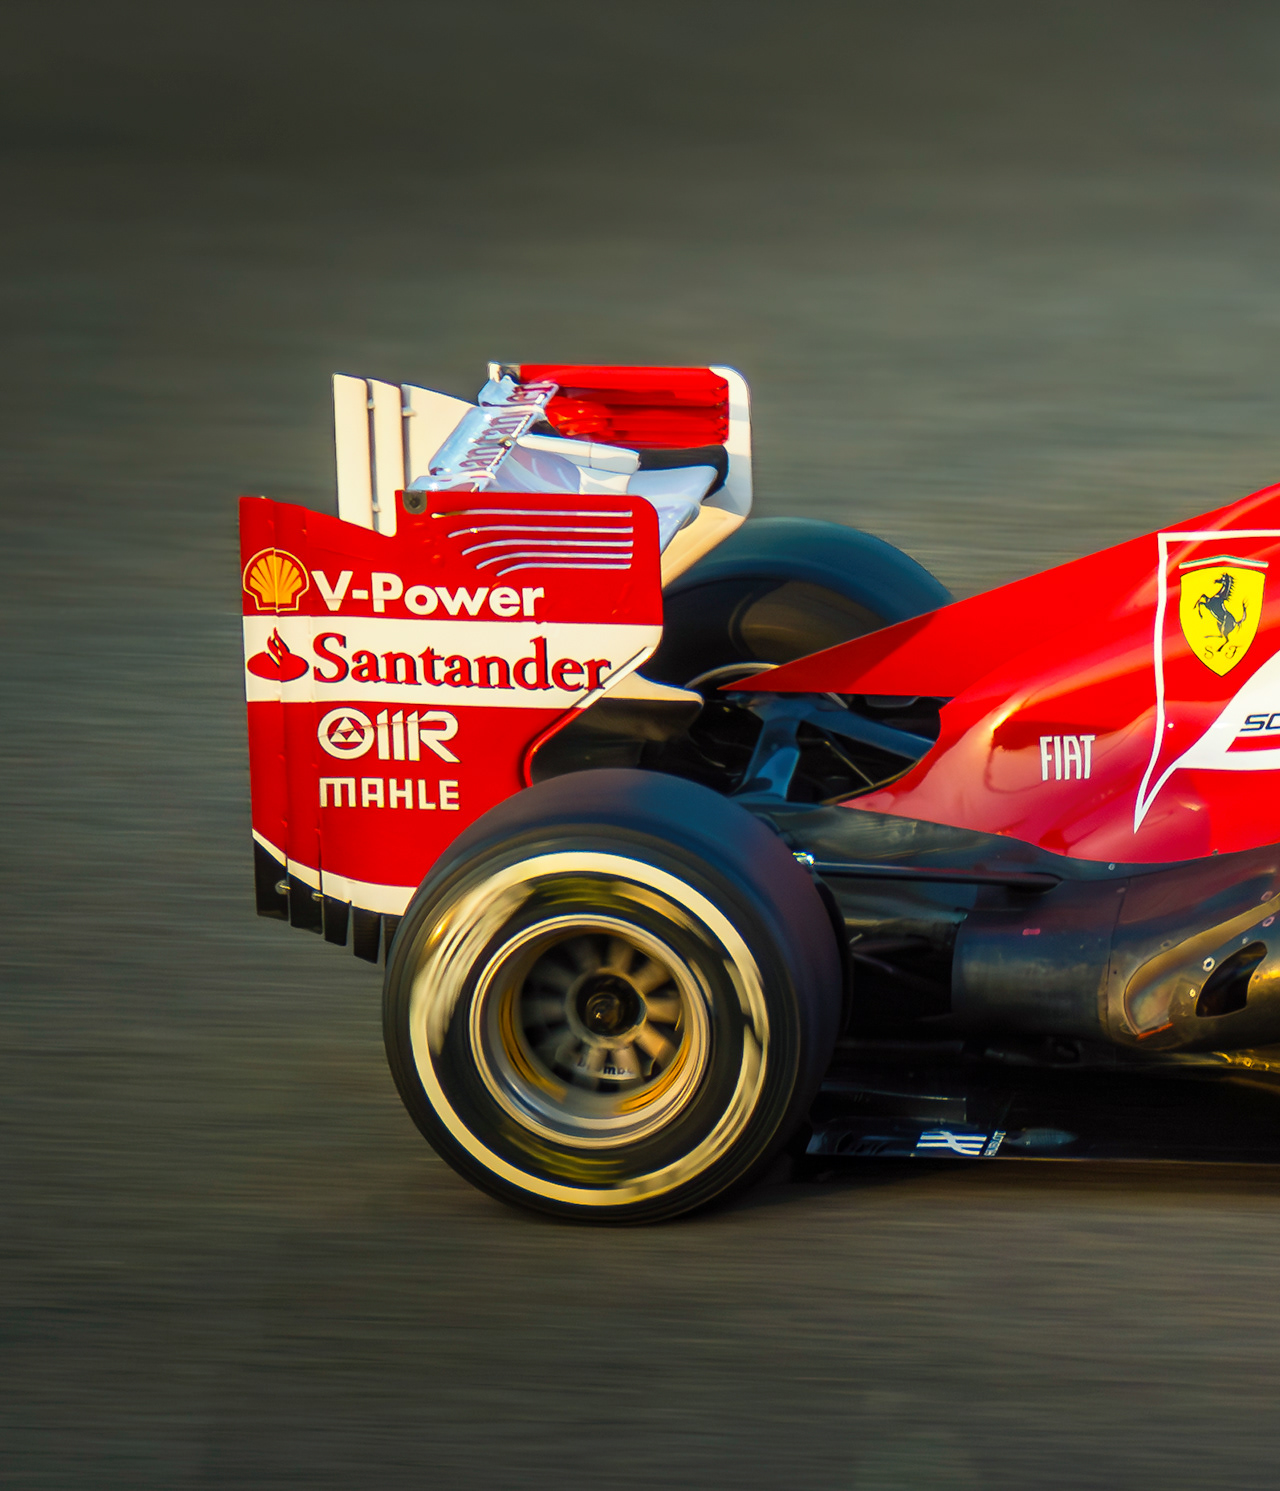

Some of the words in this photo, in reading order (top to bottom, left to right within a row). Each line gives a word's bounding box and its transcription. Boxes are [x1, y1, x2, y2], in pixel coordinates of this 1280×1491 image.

[311, 570, 544, 617] V-Power
[313, 632, 612, 691] Santander
[1040, 735, 1095, 780] FIAT
[319, 777, 460, 811] MAHLE
